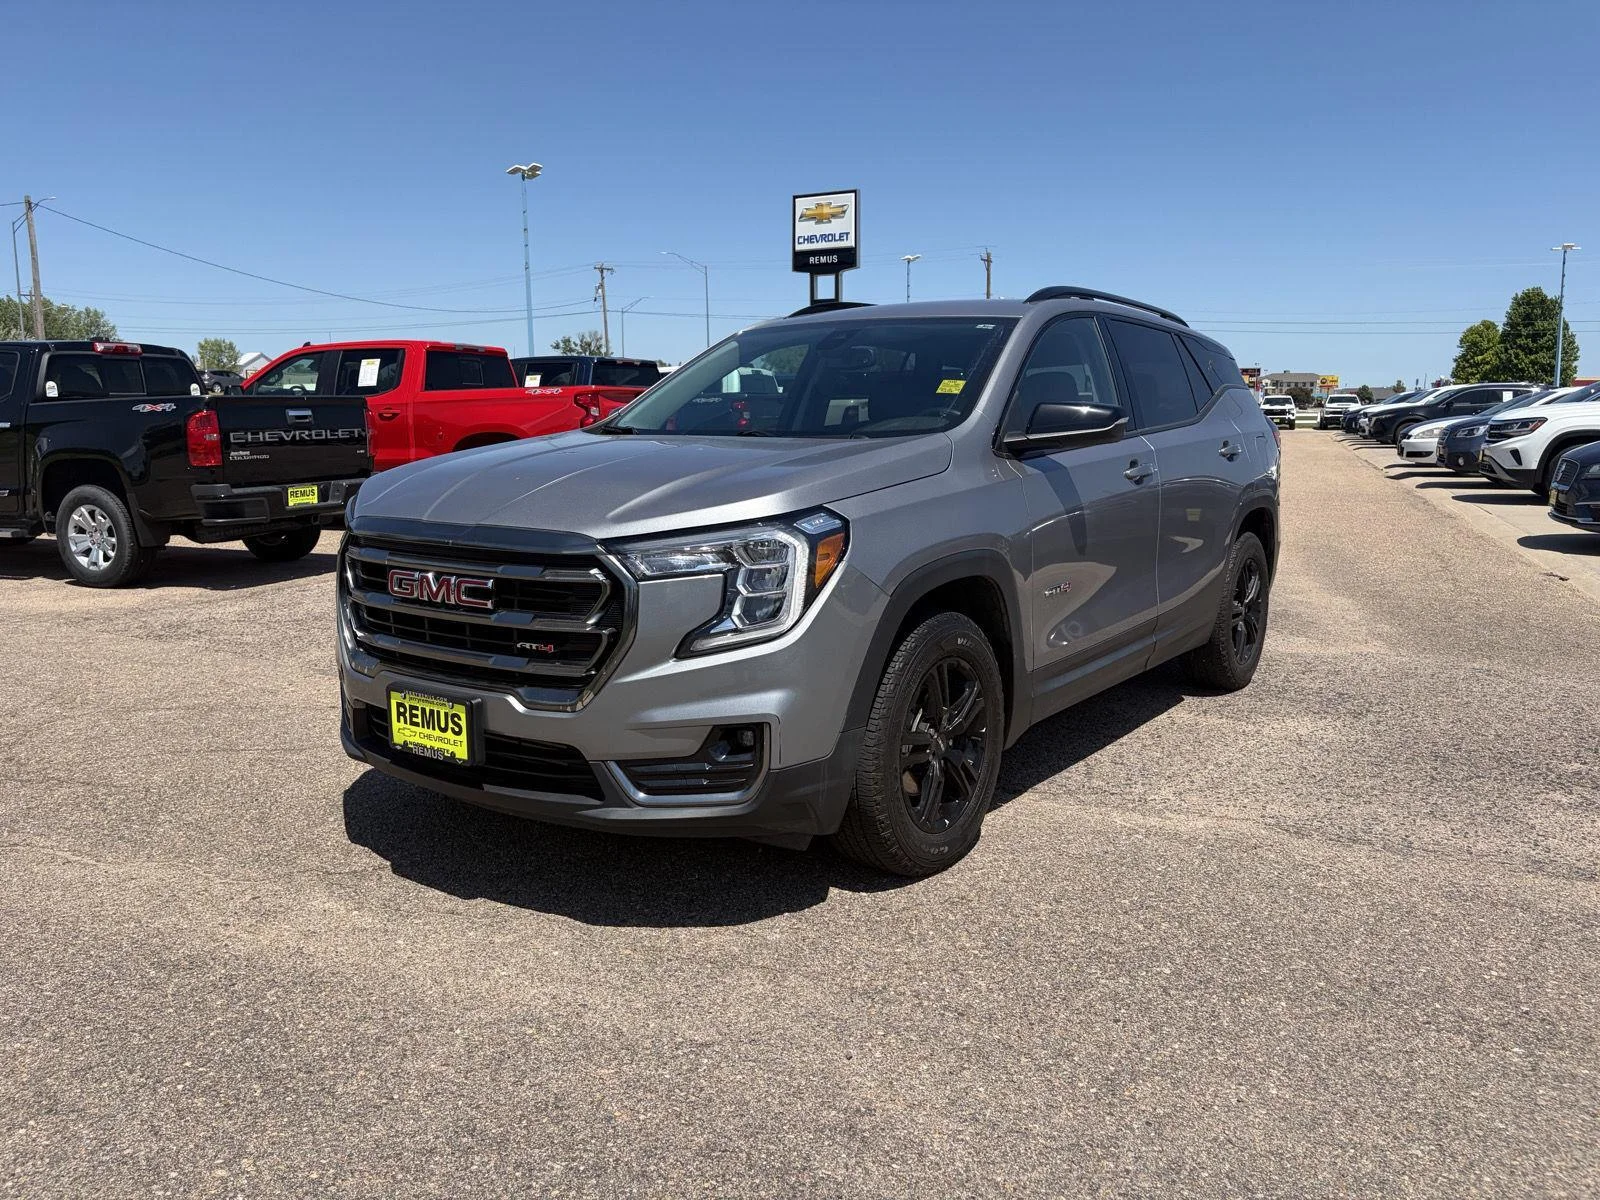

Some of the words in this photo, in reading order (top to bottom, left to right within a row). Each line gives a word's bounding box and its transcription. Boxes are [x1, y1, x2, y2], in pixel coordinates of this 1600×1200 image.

[797, 231, 850, 245] CHEVROLET
[809, 255, 838, 264] REMUS
[229, 428, 362, 443] CHEVROLET
[289, 488, 316, 499] REMUS
[388, 569, 494, 609] GMC
[516, 641, 554, 654] AT4
[395, 701, 463, 736] REMUS
[418, 732, 464, 747] CHEVROLET
[412, 745, 444, 761] REMUS
